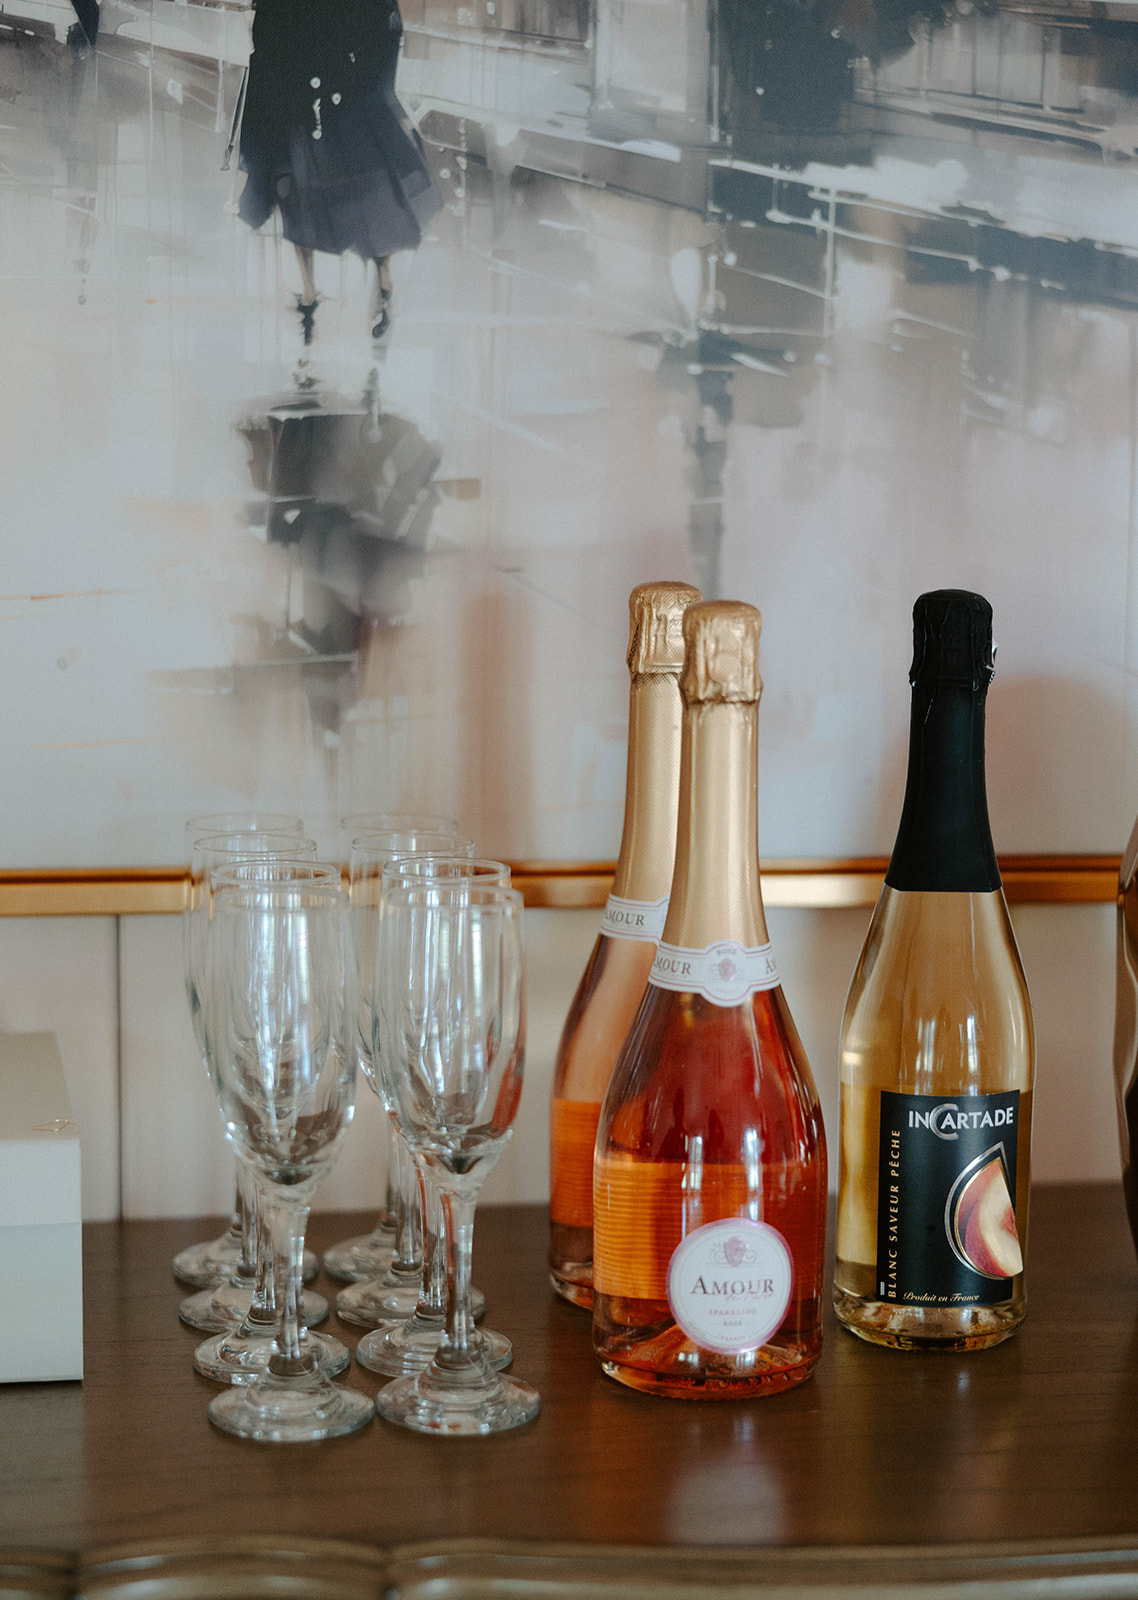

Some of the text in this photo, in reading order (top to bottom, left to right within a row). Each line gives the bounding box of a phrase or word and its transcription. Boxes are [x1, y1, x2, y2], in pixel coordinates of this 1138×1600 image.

[605, 909, 645, 926] MOUR
[652, 955, 691, 975] MOUR
[908, 1103, 1014, 1141] INCARTADE
[888, 1129, 900, 1298] BLANC SAVEUR PÊCHE
[690, 1274, 775, 1296] AMOUR
[902, 1292, 937, 1302] Produit
[949, 1293, 980, 1302] France
